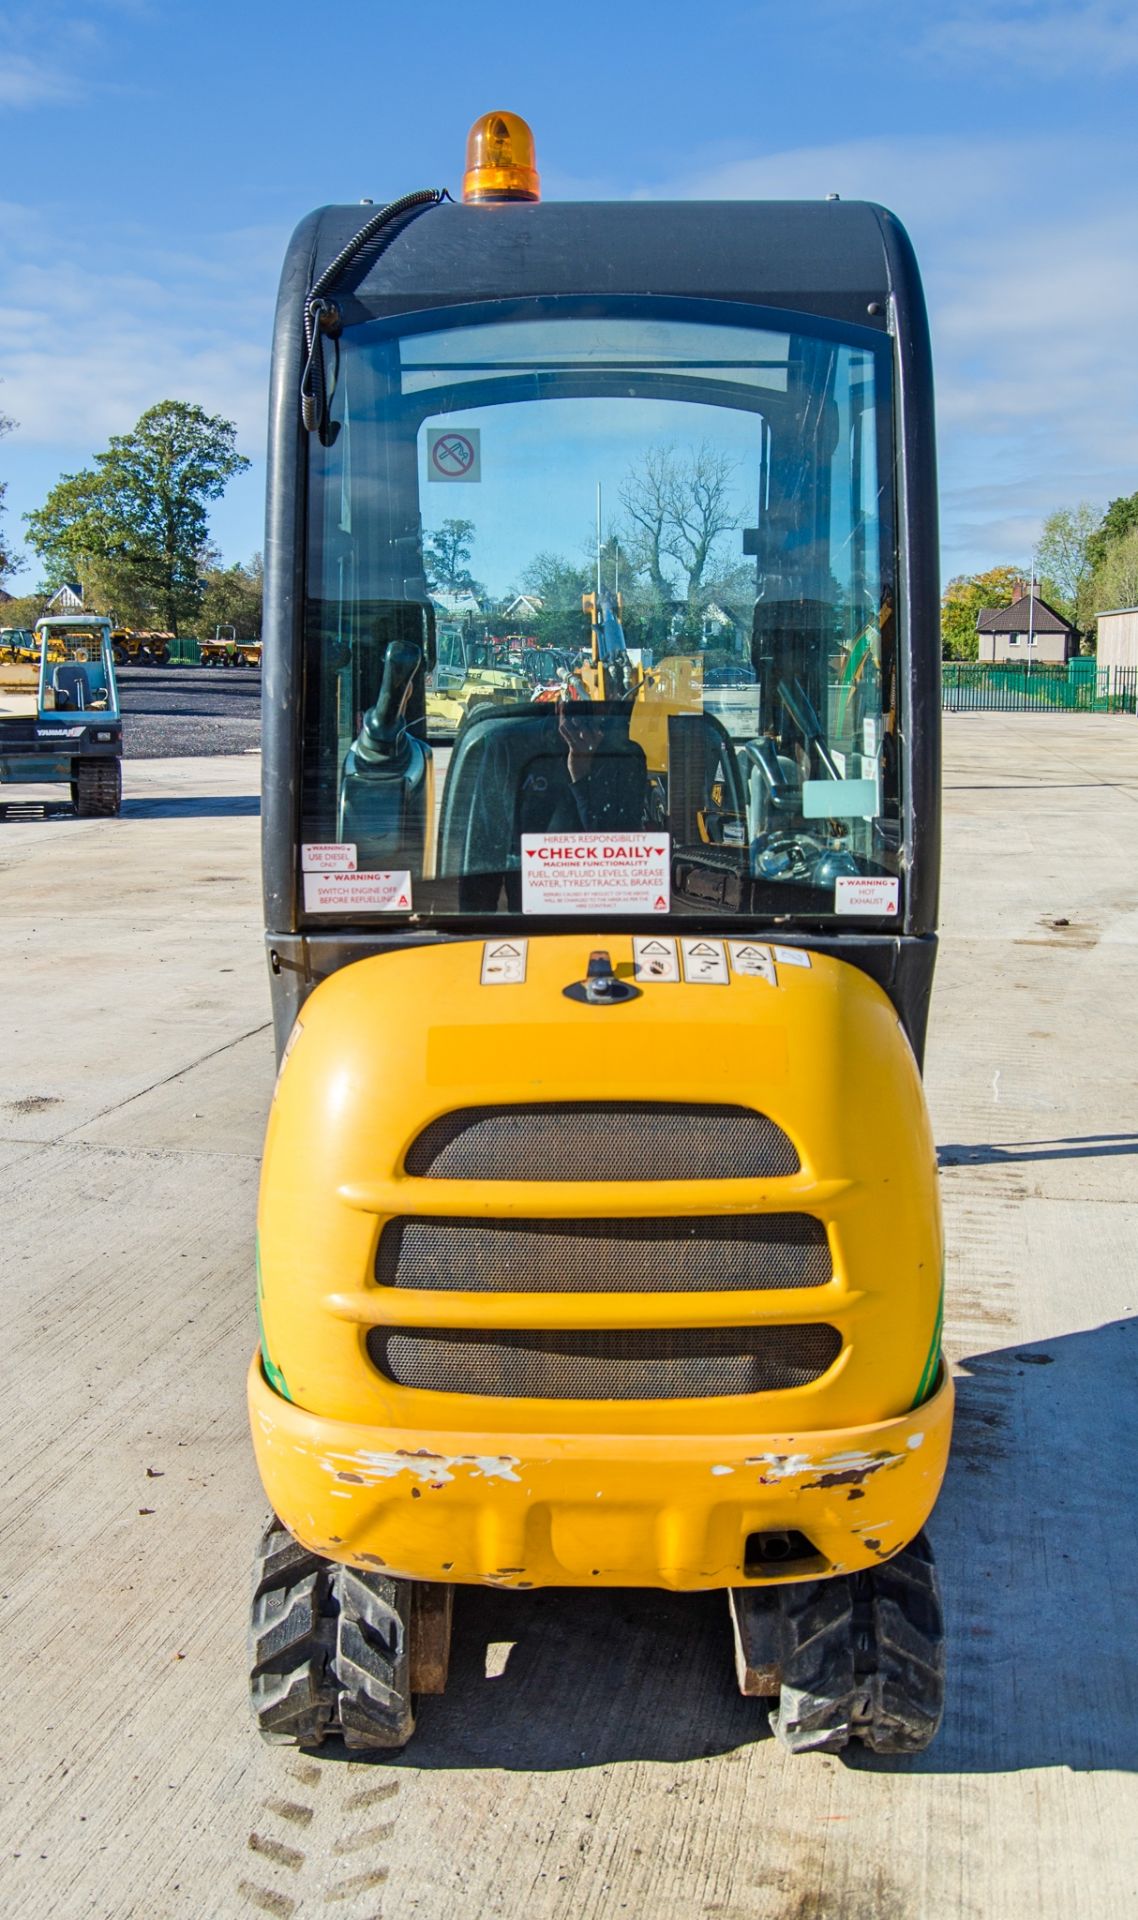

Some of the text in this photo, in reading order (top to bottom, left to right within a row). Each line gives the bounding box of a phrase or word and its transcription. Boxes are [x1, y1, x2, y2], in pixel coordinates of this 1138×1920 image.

[543, 834, 647, 843] HIRER'S RESPONSIBILITY
[308, 853, 349, 861] USE DIESEL
[537, 846, 653, 859] CHECK DAILY
[552, 870, 595, 878] OIL/FLUID
[631, 869, 664, 877] GREASE
[630, 878, 664, 887] BRAKES
[318, 885, 397, 895] SWITCH ENGINE OFF
[319, 896, 348, 904] BEFORE
